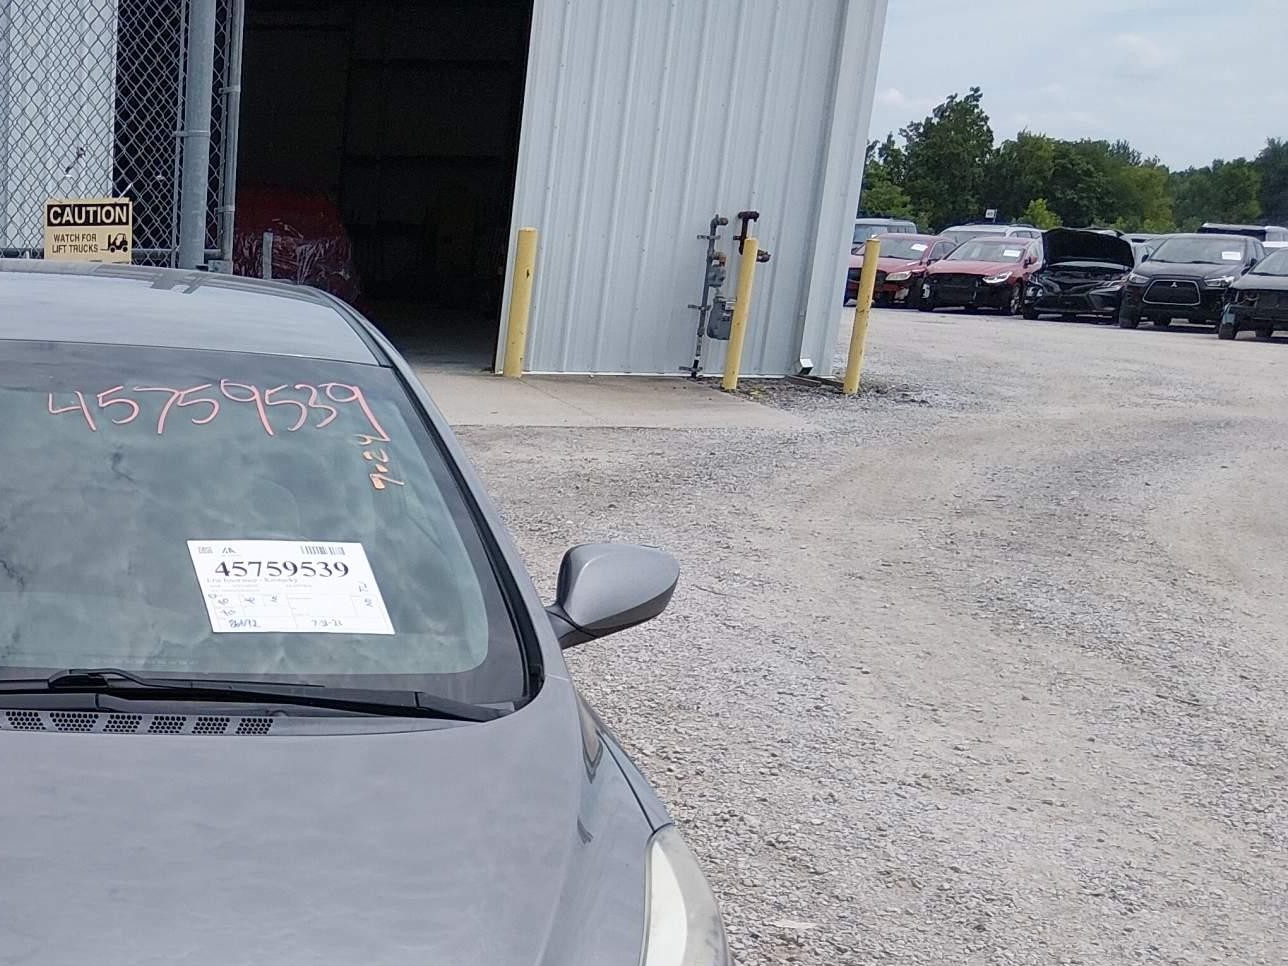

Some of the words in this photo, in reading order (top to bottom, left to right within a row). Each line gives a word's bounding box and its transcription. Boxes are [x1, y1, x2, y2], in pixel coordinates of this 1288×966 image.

[49, 205, 127, 224] CAUTION
[53, 233, 80, 243] WATCH
[81, 233, 97, 242] FOR
[52, 244, 67, 254] LIFT
[69, 244, 99, 253] TRUCKS
[47, 378, 392, 442] 45759539
[214, 561, 349, 578] 45759539
